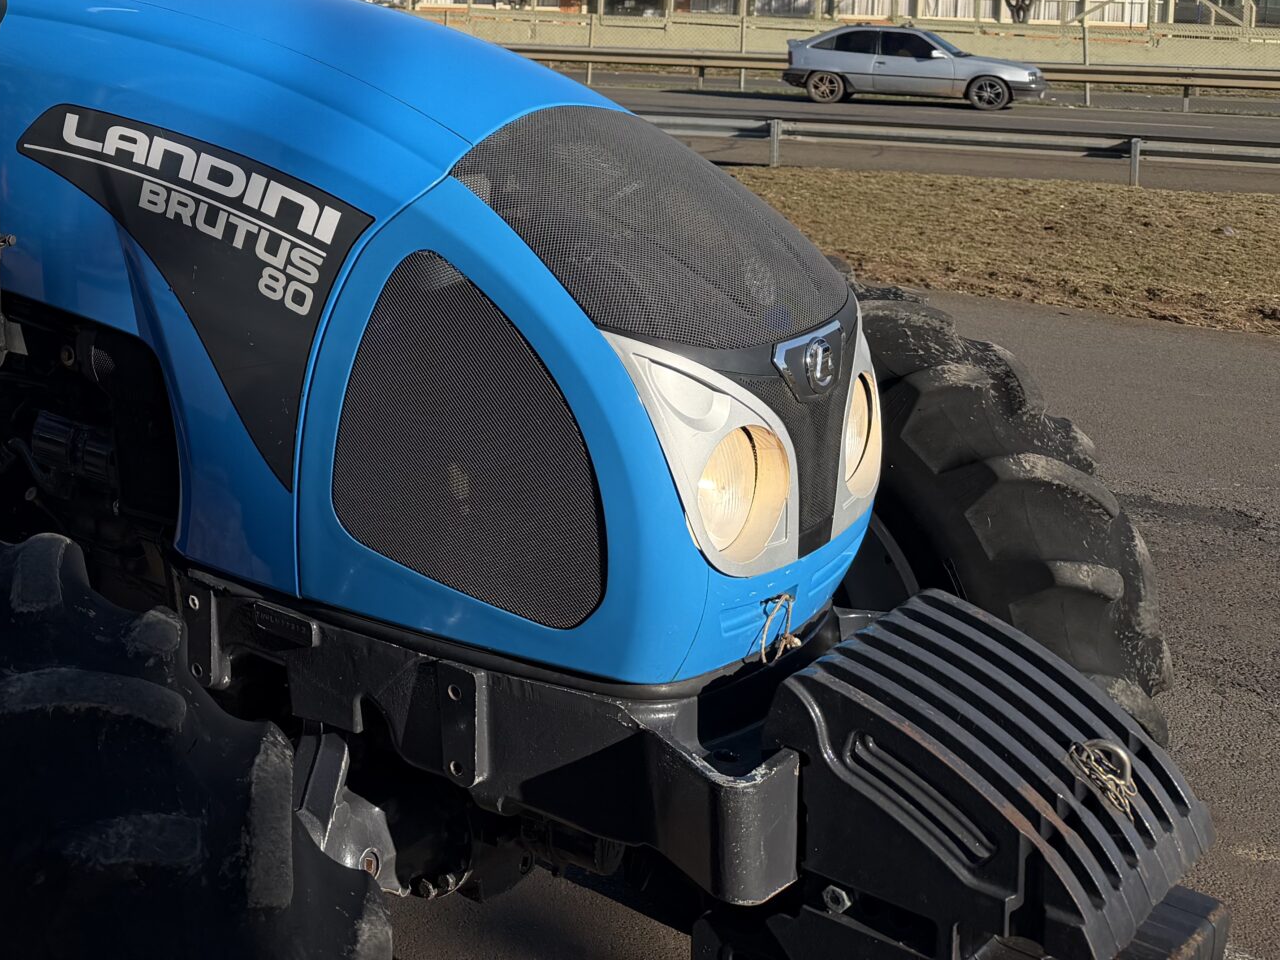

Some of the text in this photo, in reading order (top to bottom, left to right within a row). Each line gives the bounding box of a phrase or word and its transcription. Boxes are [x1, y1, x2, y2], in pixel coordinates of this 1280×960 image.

[62, 113, 342, 245] LANDINI
[138, 180, 324, 284] BRUTUS
[258, 266, 314, 316] 80
